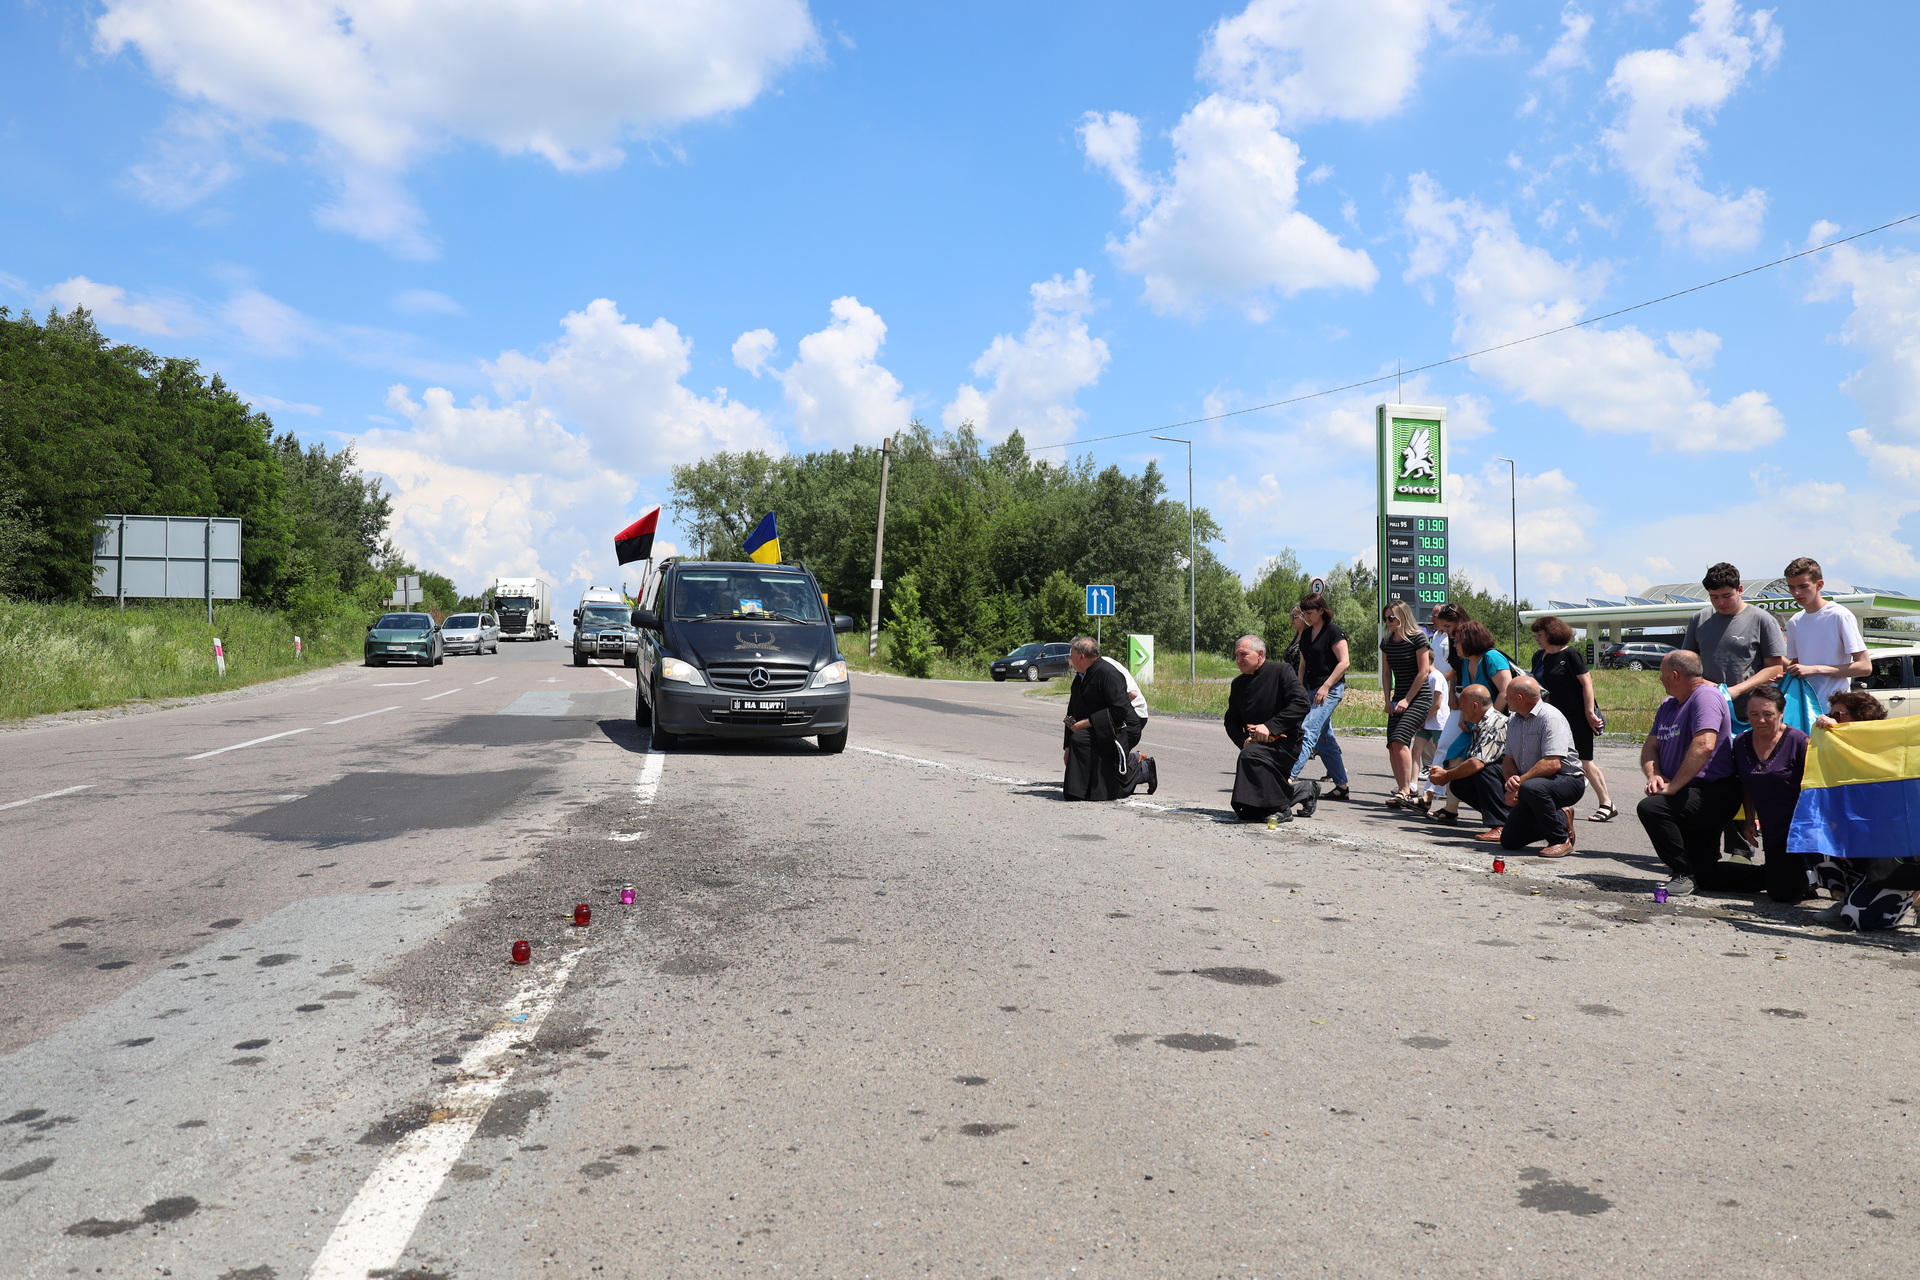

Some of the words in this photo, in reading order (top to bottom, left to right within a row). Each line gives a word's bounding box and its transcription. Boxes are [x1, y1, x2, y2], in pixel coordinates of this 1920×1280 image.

[1397, 485, 1440, 495] OKKO
[1418, 519, 1444, 532] 81.90
[1418, 536, 1445, 549] 78.90
[1418, 554, 1445, 567] 84.90
[1418, 572, 1445, 585] 81.90
[1315, 583, 1320, 593] 5
[1418, 590, 1445, 603] 43.90
[1755, 600, 1804, 611] OKK
[744, 701, 757, 709] НА
